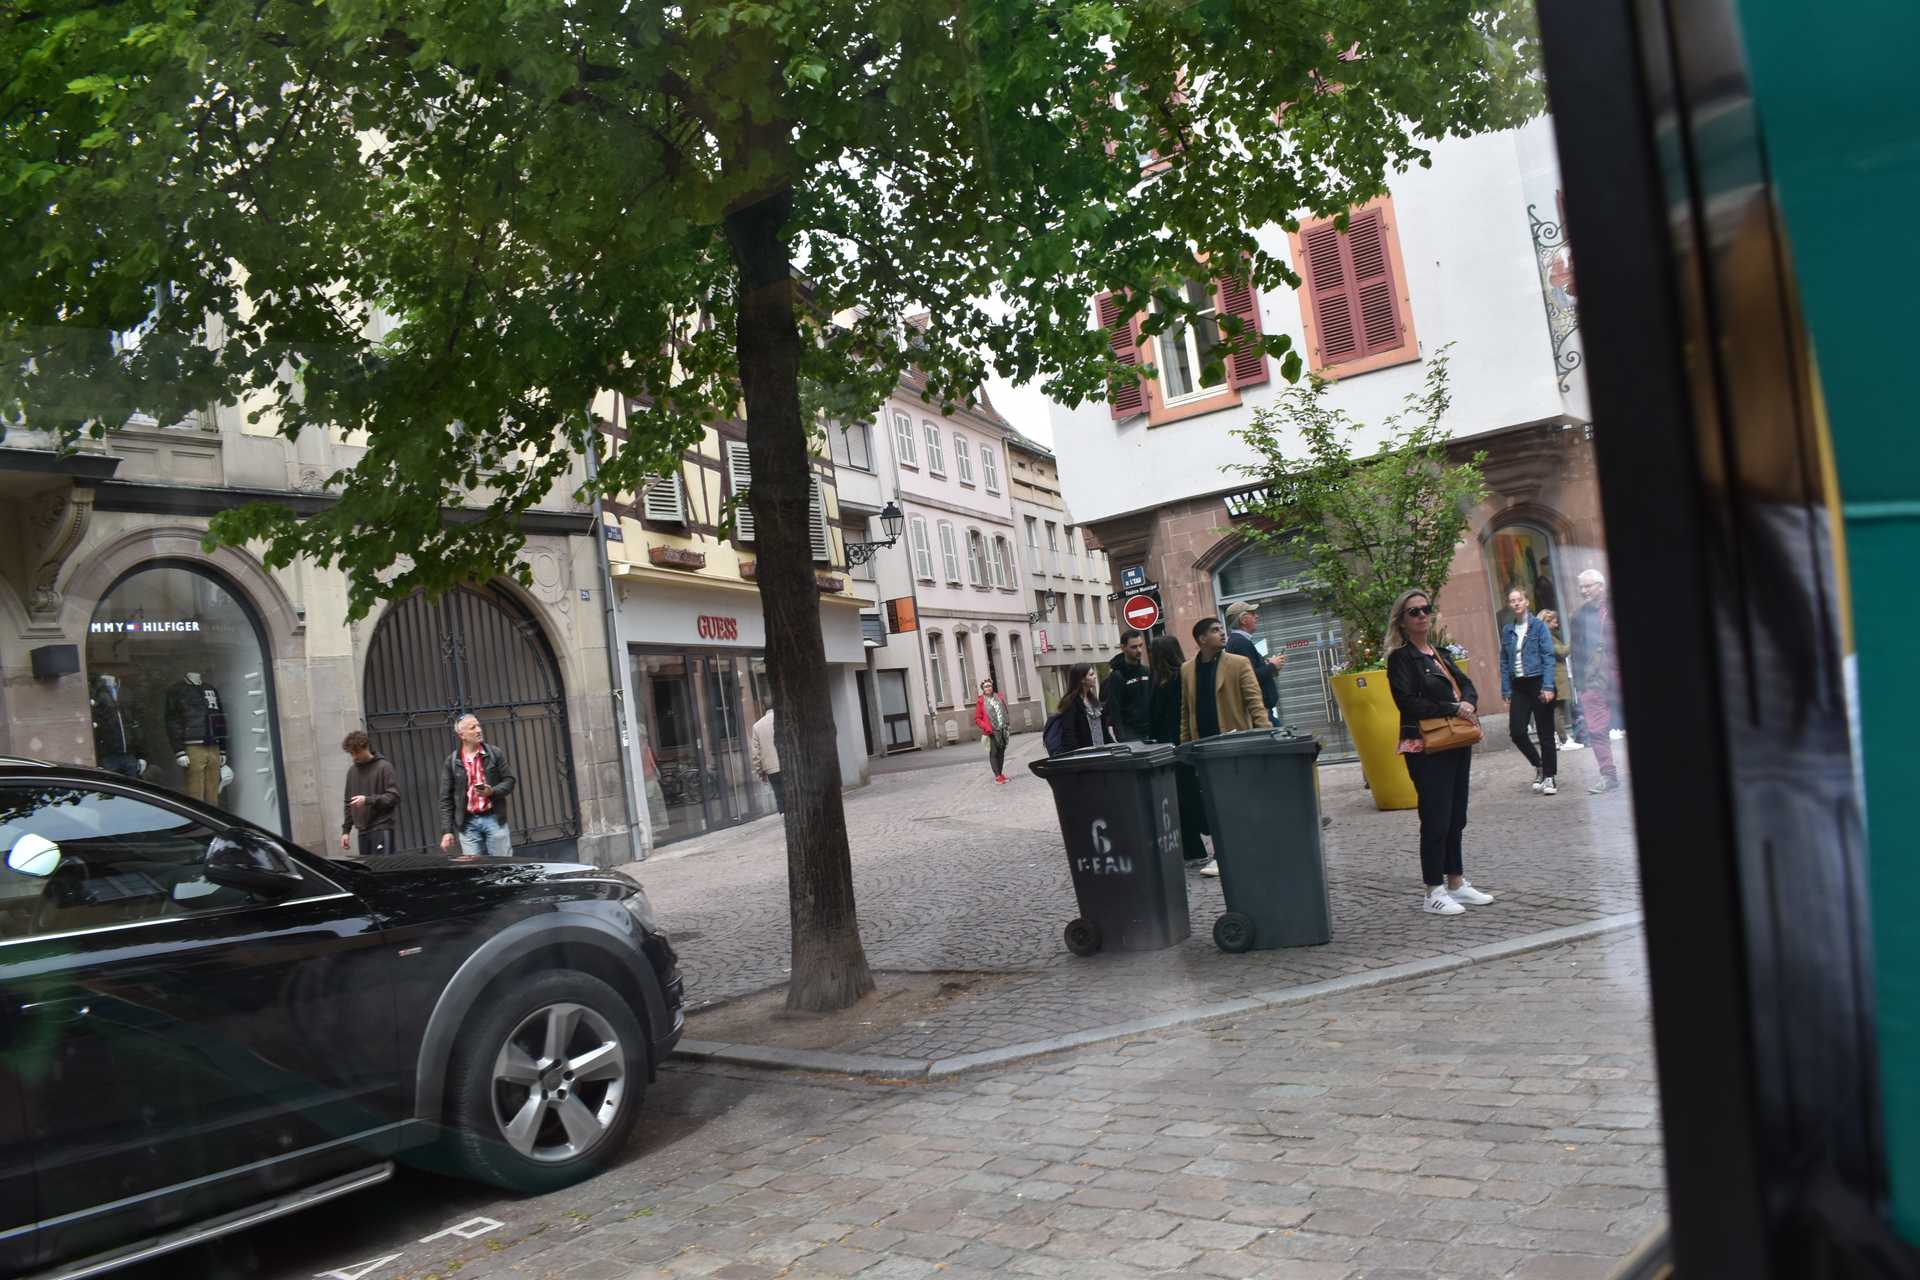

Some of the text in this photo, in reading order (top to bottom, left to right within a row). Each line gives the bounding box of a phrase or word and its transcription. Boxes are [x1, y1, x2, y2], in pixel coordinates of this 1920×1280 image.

[143, 621, 200, 632] HILFIGER
[697, 615, 737, 640] GUESS
[1092, 819, 1112, 854] 6
